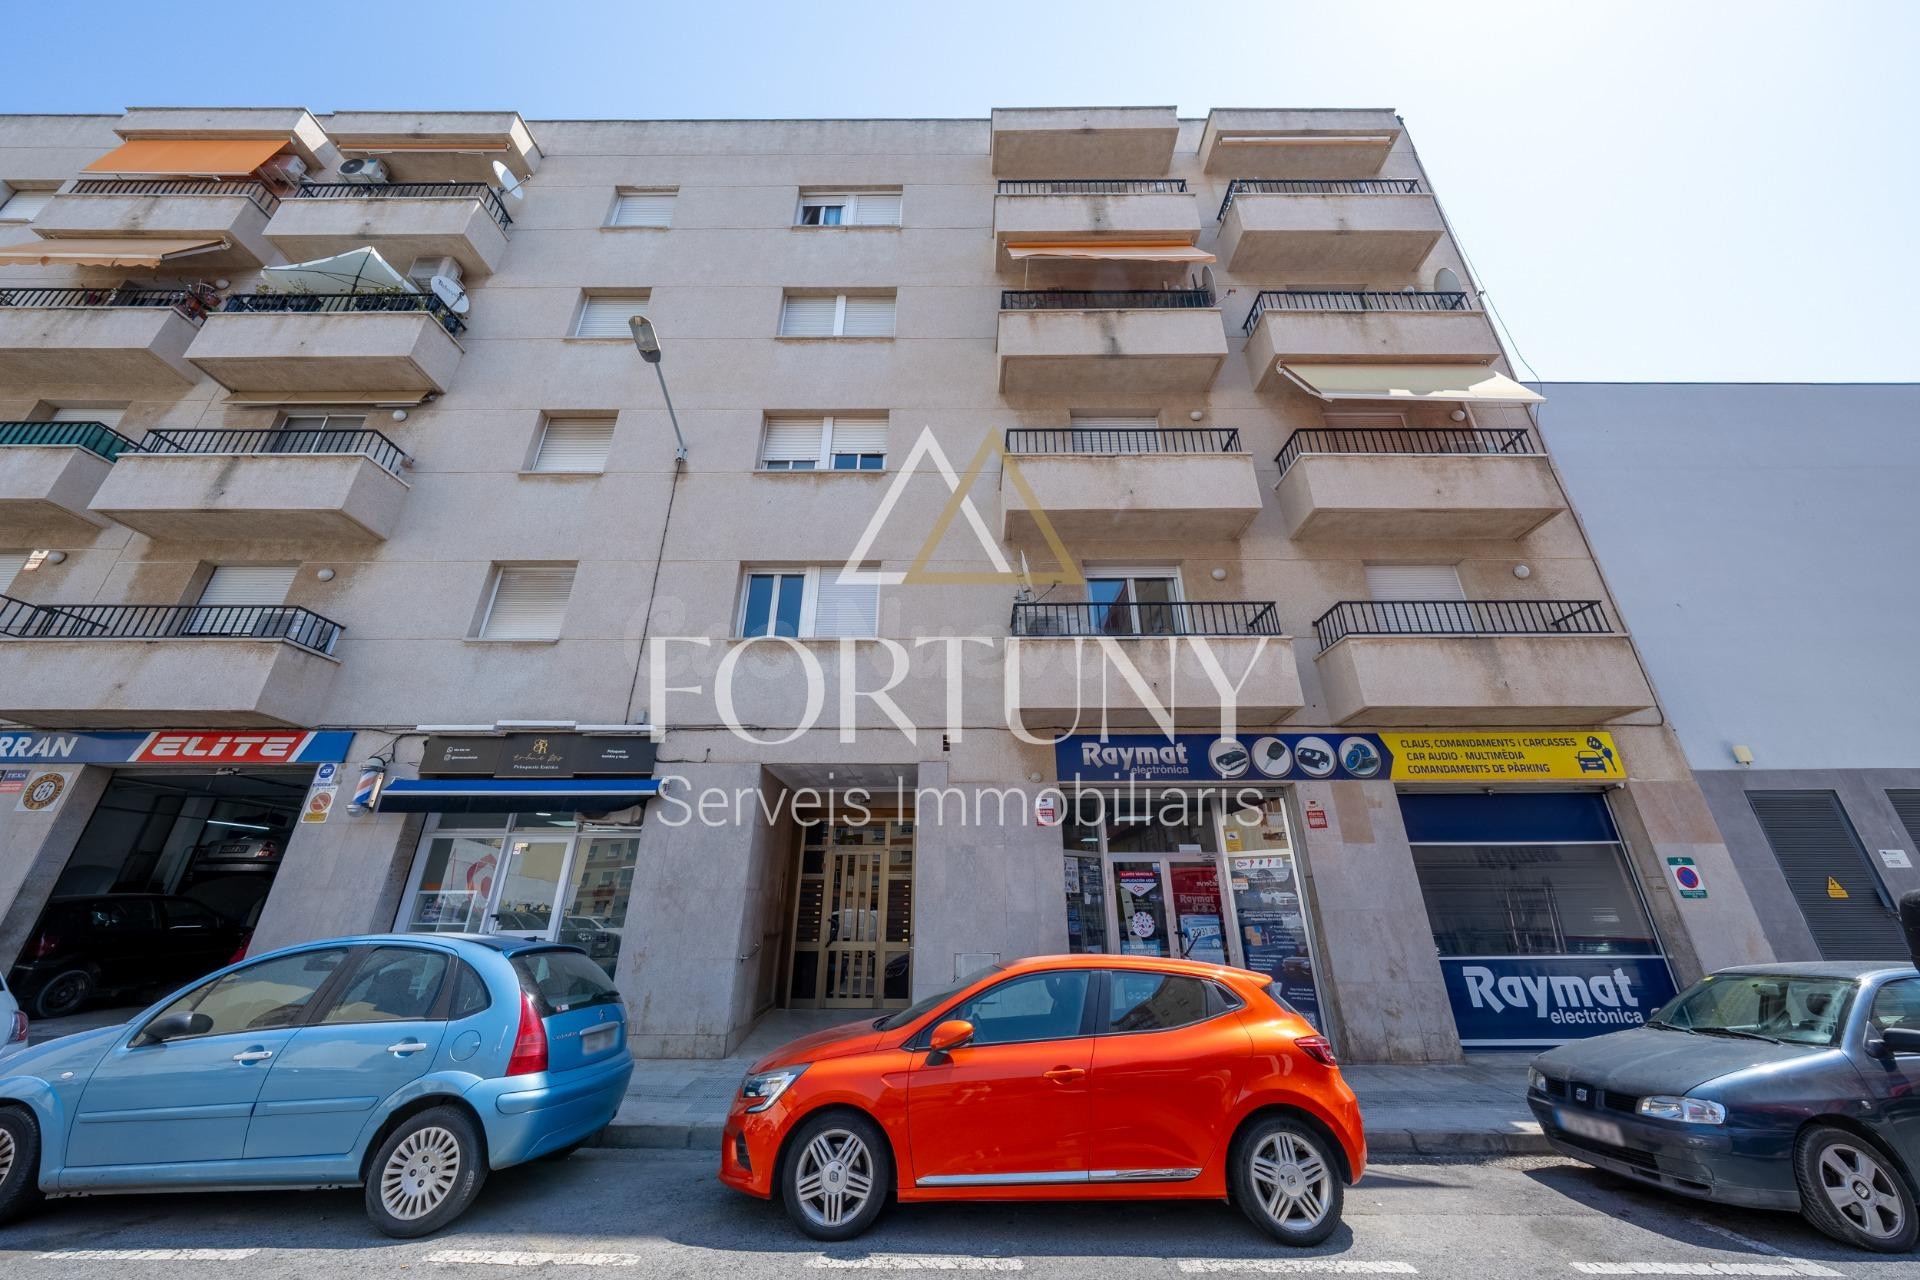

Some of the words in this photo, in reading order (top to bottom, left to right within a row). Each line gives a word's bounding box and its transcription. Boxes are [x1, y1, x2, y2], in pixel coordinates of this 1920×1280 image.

[1400, 739, 1434, 749] CLAUS,
[1434, 738, 1516, 747] COMANDAMENTS
[1522, 737, 1577, 747] CARCASSES
[1081, 742, 1188, 771] Raymat
[1406, 752, 1426, 761] CAR
[1428, 751, 1458, 761] AUDIO
[1407, 764, 1491, 774] COMANDAMENTS
[1492, 764, 1506, 773] DE
[1462, 966, 1639, 1018] Raymat
[1550, 1008, 1645, 1025] electrònica
